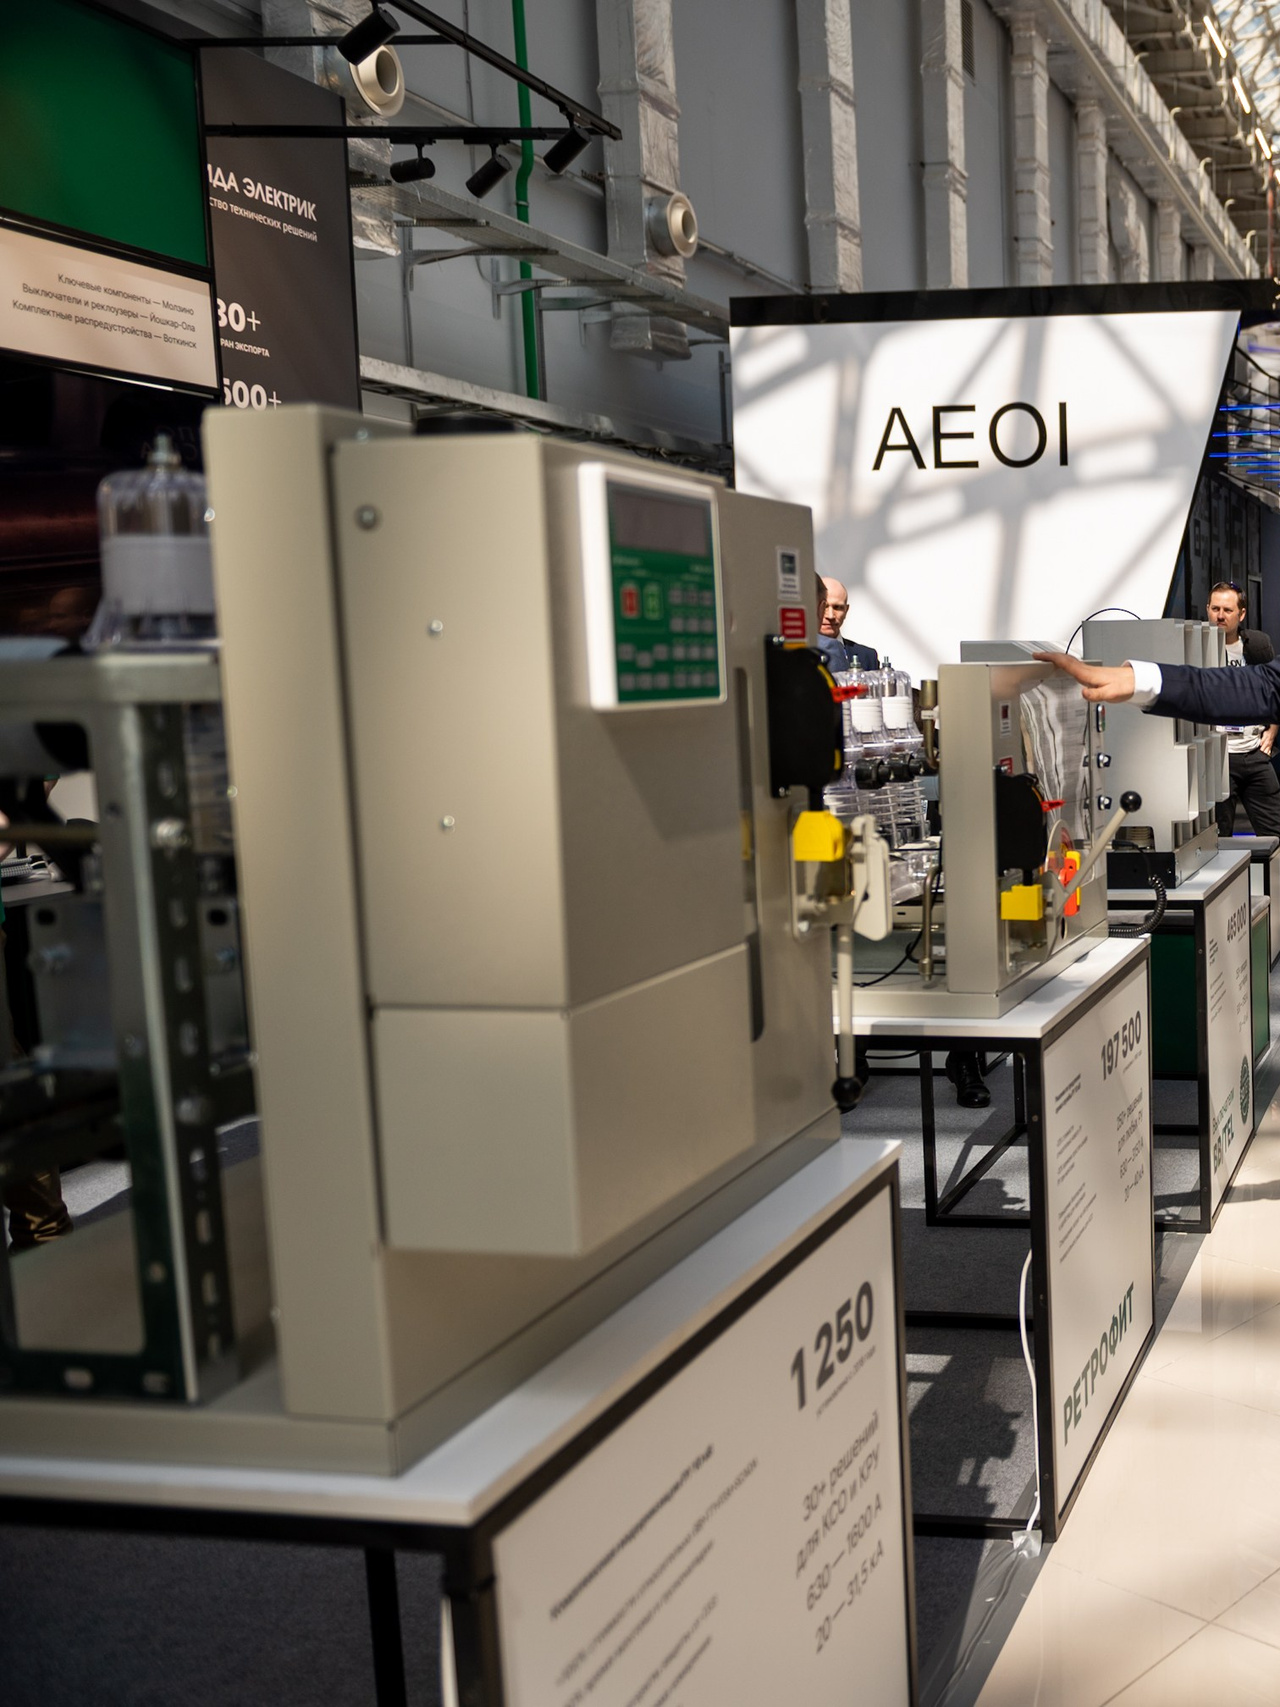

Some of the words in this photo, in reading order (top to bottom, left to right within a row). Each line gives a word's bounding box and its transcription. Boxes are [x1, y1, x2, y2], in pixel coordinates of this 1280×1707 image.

[229, 204, 281, 230] технических
[282, 222, 318, 242] решений
[242, 177, 317, 221] ЭЛЕКТРИК
[22, 283, 82, 305] Выключатели
[91, 301, 139, 319] реклоузеры
[149, 312, 196, 332] Йошкар-Ола
[58, 273, 102, 293] Ключевые
[103, 287, 152, 305] компоненты
[162, 300, 195, 315] Молзино
[12, 300, 72, 322] Комплектные
[74, 315, 153, 339] распредустройства
[163, 333, 197, 349] Воткинск
[235, 341, 270, 357] ЭКСПОРТА
[872, 402, 1068, 471] AEOI
[1063, 1281, 1134, 1447] РЕТРОФИТ
[803, 1481, 826, 1521] 30+
[830, 1409, 878, 1495] решений
[796, 1529, 820, 1579] для
[822, 1489, 847, 1538] КСО
[850, 1479, 857, 1502] и
[859, 1443, 879, 1488] КРУ
[807, 1563, 830, 1611] 630
[847, 1504, 872, 1554] 1600
[816, 1615, 831, 1654] 20
[870, 1540, 884, 1573] кА
